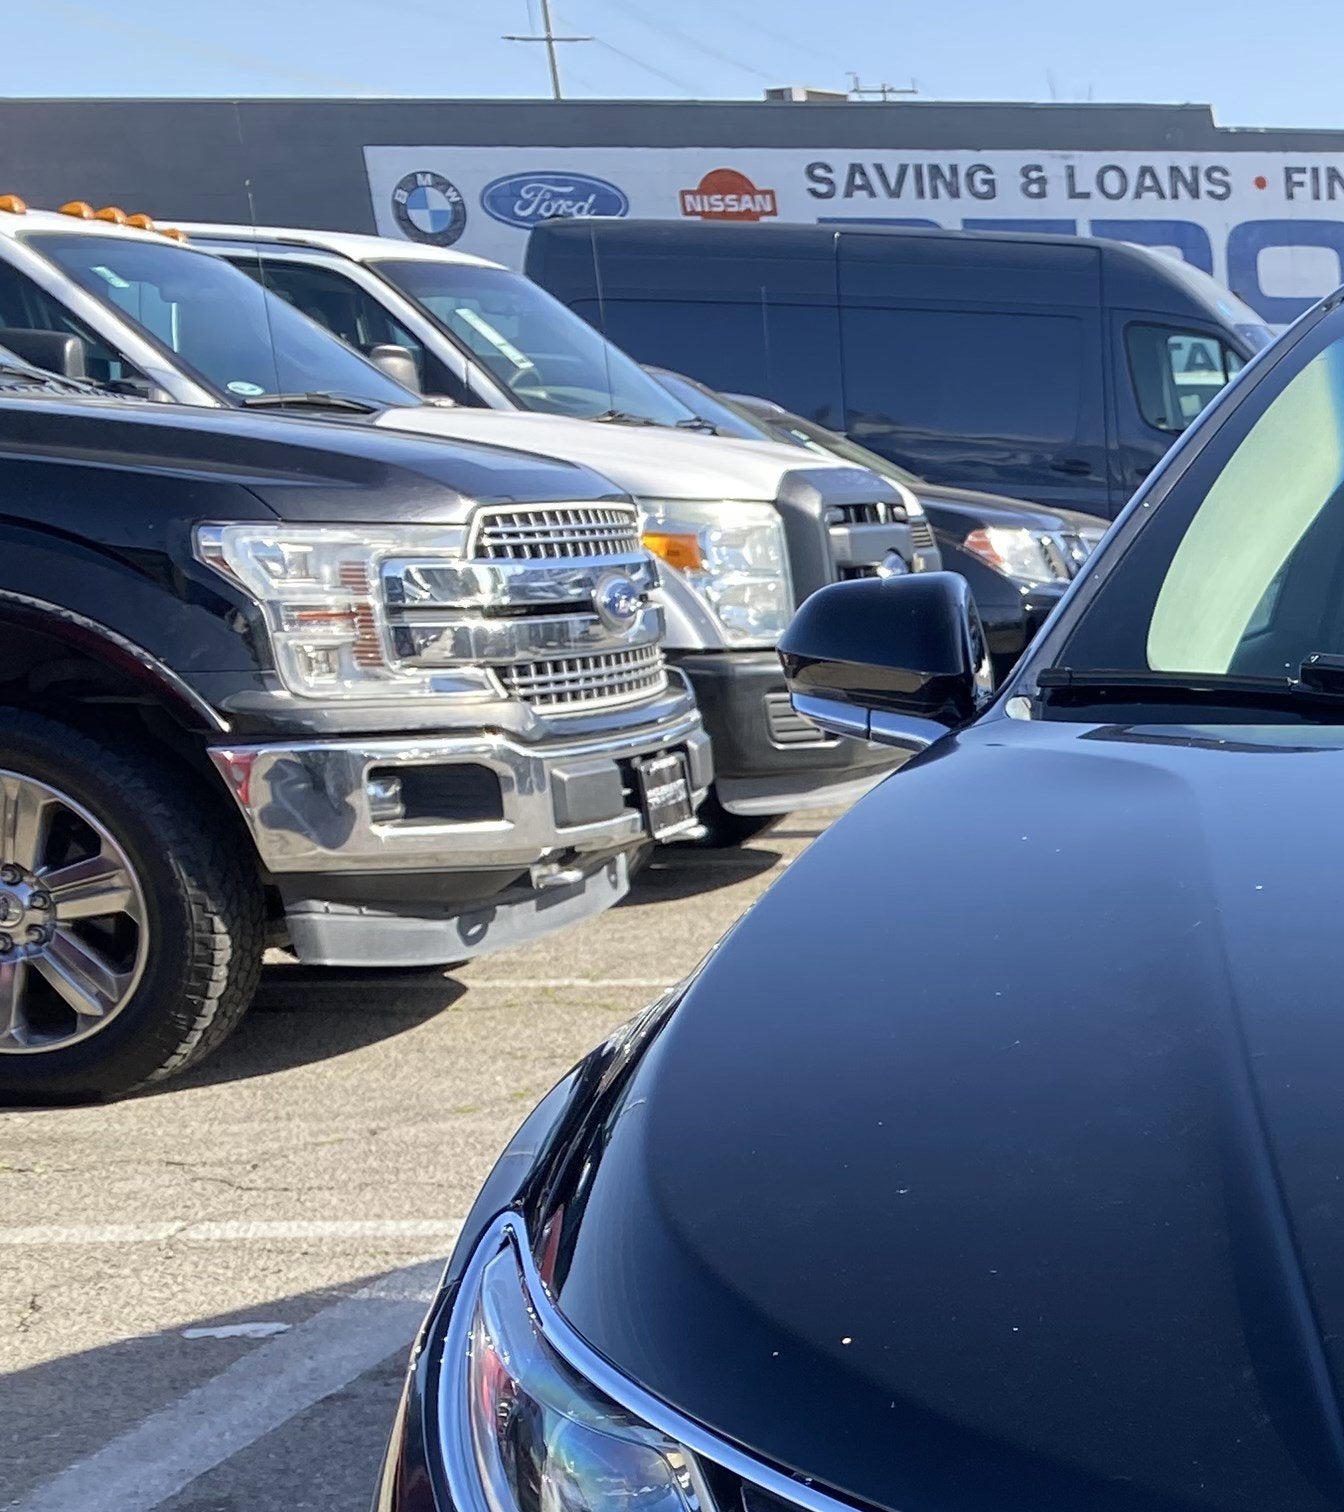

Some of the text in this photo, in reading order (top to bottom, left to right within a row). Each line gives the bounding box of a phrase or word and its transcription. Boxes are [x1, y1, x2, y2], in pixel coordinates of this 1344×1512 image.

[394, 172, 462, 205] BMW
[804, 161, 998, 201] SAVING
[1019, 163, 1048, 200] &
[1064, 164, 1233, 202] LOANS
[513, 182, 597, 217] Ford
[683, 193, 773, 213] NISSAN
